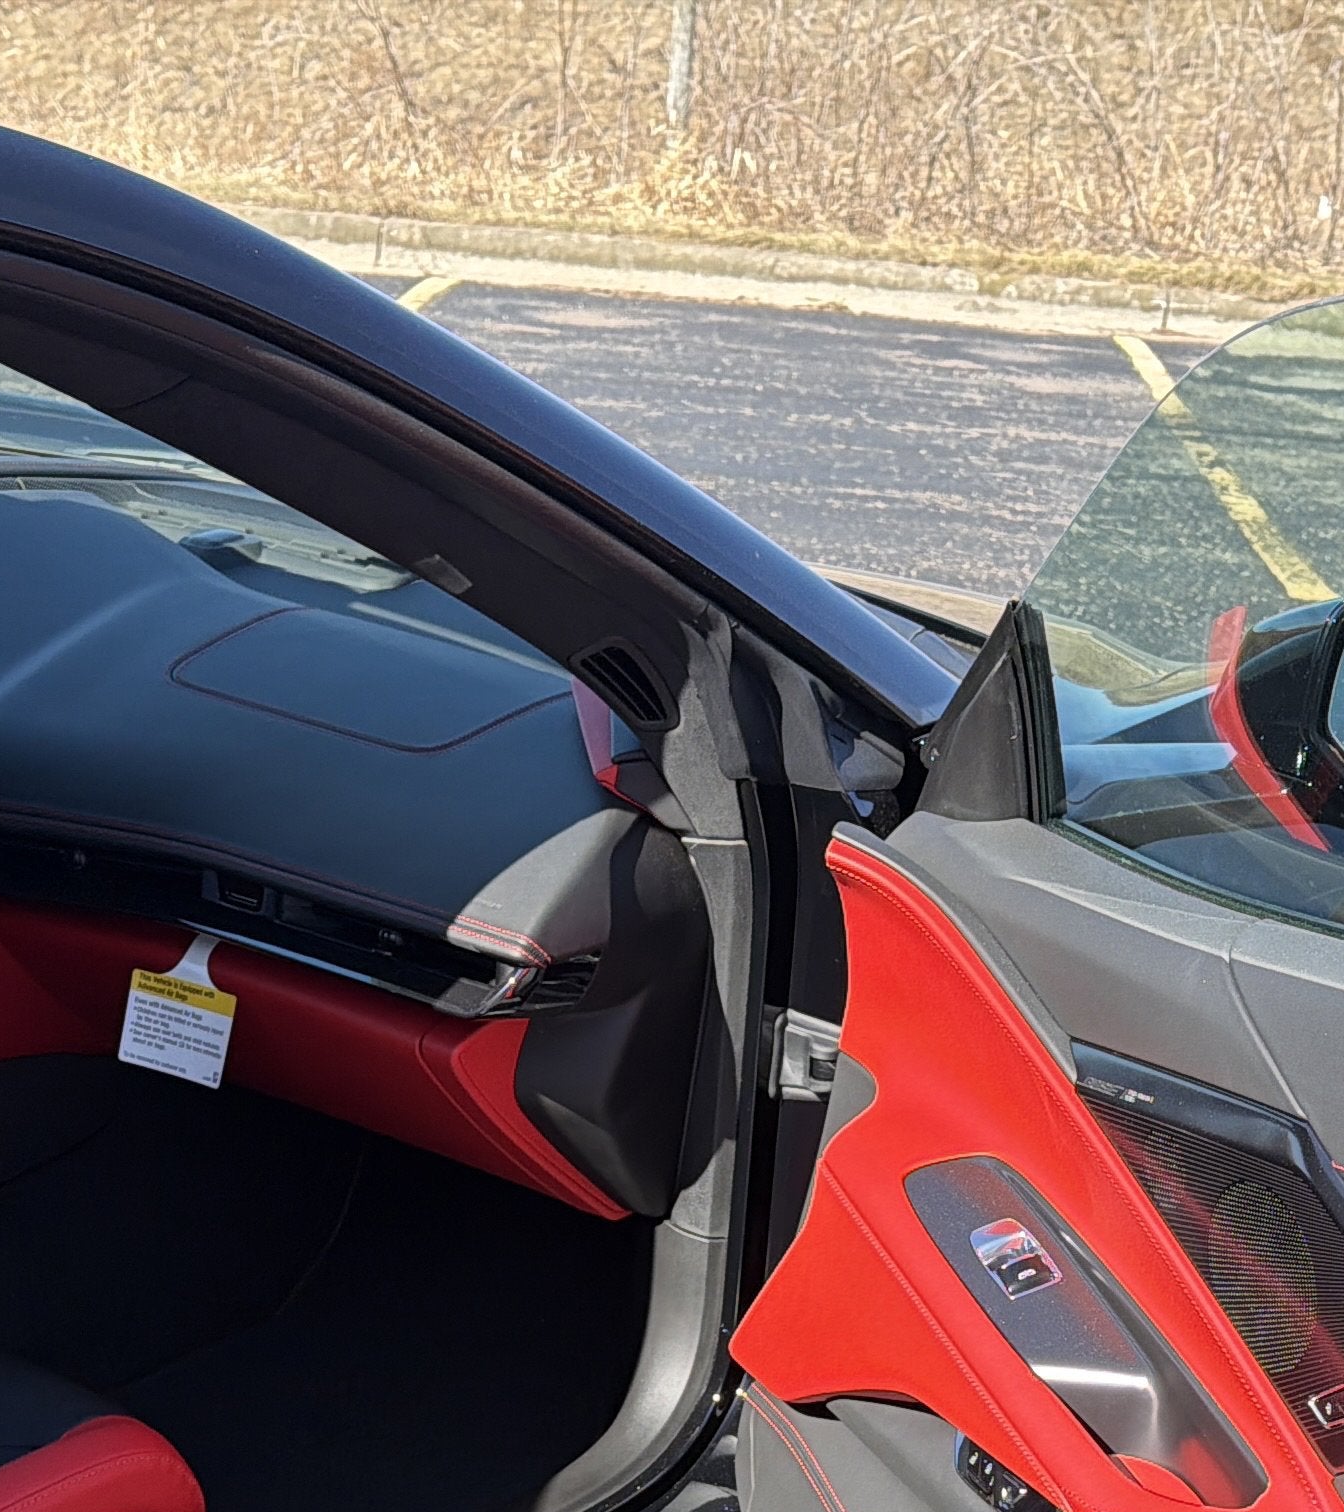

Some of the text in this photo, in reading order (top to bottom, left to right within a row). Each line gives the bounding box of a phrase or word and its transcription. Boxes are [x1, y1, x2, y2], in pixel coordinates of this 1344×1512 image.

[137, 981, 166, 995] Advanced
[175, 991, 188, 1002] Bags
[154, 976, 172, 987] Vehicle
[179, 983, 203, 997] Equipped
[204, 989, 215, 999] with
[149, 1001, 160, 1009] with
[161, 1003, 183, 1015] Advanced
